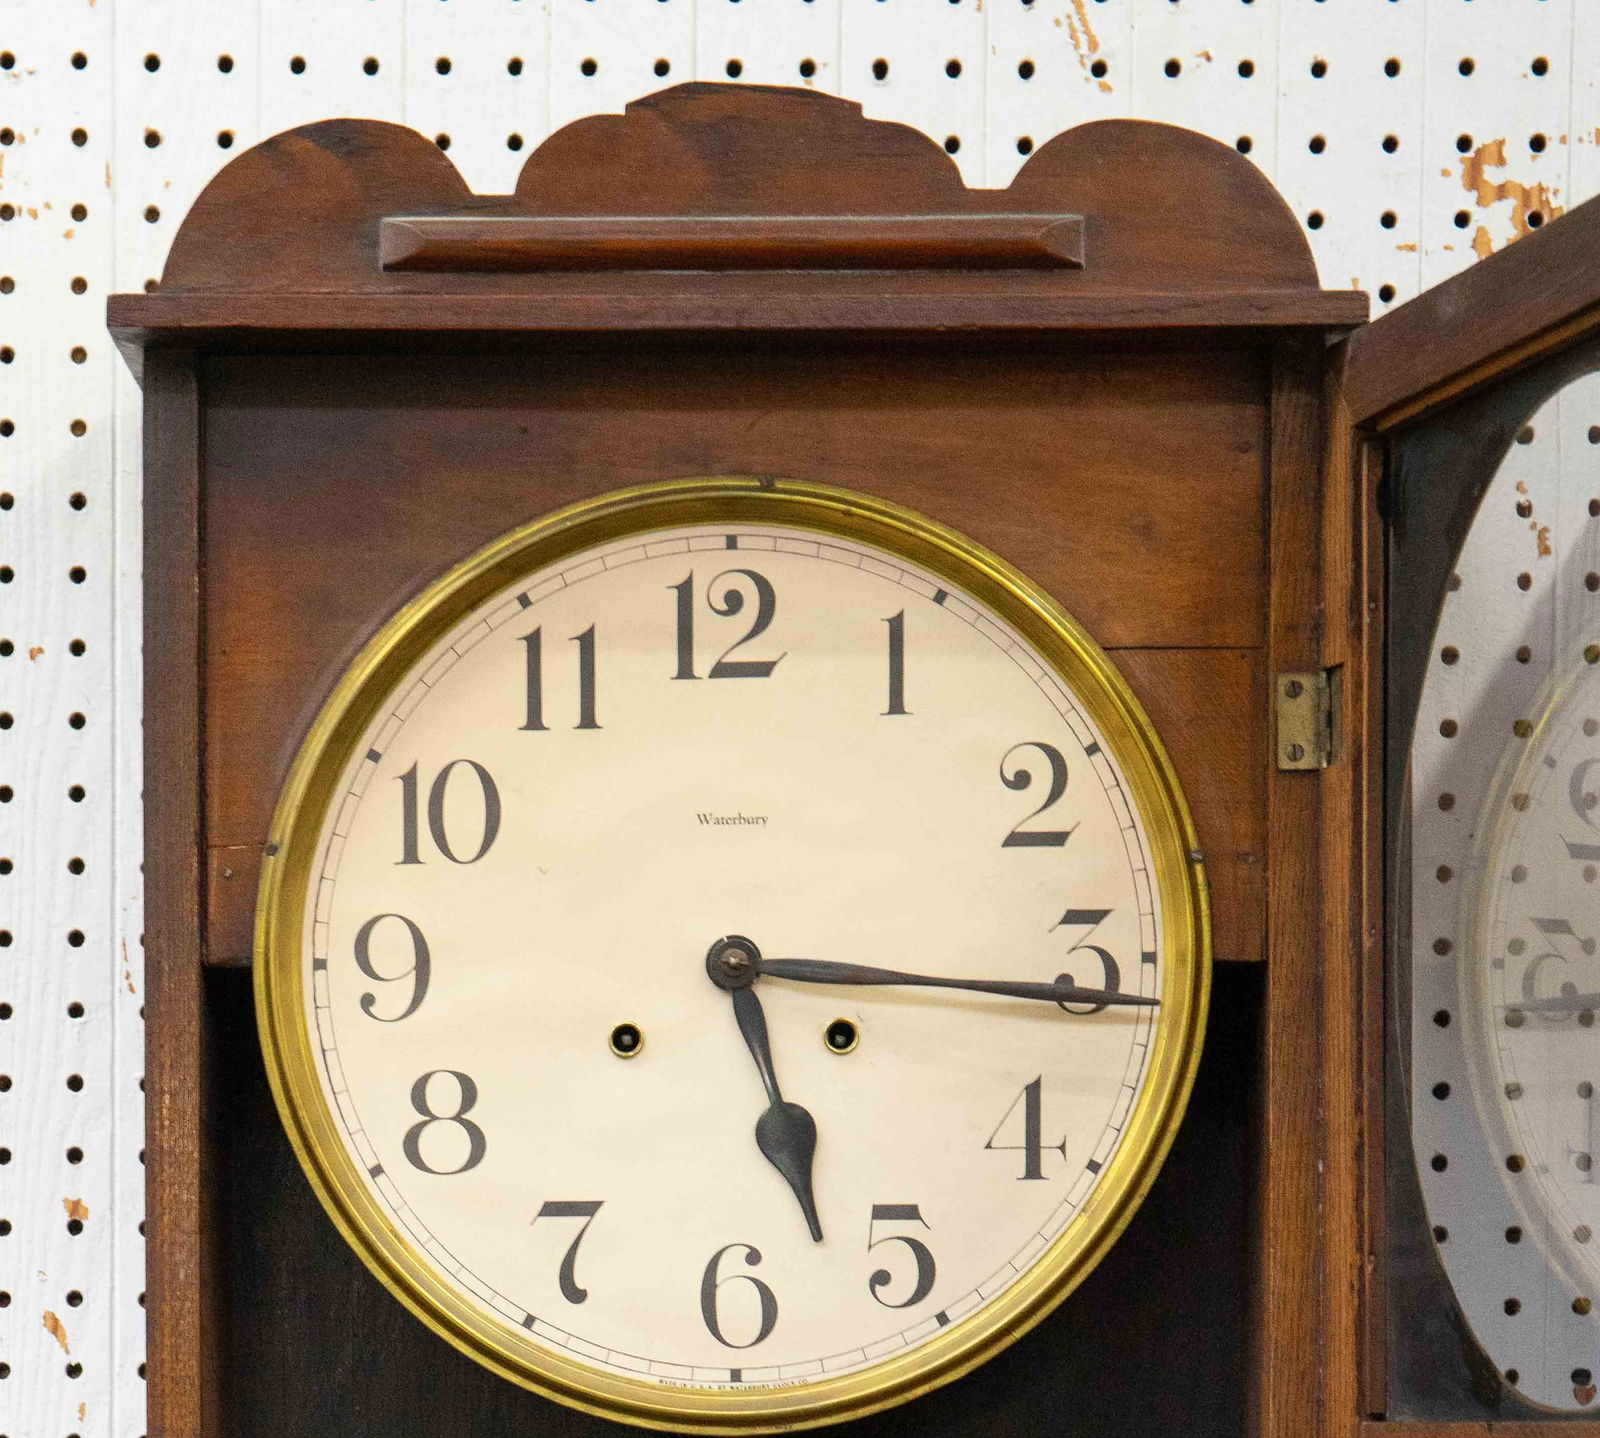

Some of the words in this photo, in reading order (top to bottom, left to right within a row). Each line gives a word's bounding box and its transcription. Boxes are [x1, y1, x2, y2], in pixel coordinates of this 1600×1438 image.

[516, 623, 603, 732] 11
[666, 568, 788, 681] 12
[879, 608, 912, 717] 1
[394, 758, 502, 867] 10
[696, 812, 770, 828] Waterbury
[997, 741, 1081, 848] 2
[353, 913, 431, 1023] 9
[1047, 908, 1121, 1015] 3
[402, 1068, 487, 1176] 8
[983, 1075, 1068, 1181] 4
[530, 1200, 605, 1306] 7
[700, 1242, 778, 1349] 6
[866, 1202, 938, 1309] 5
